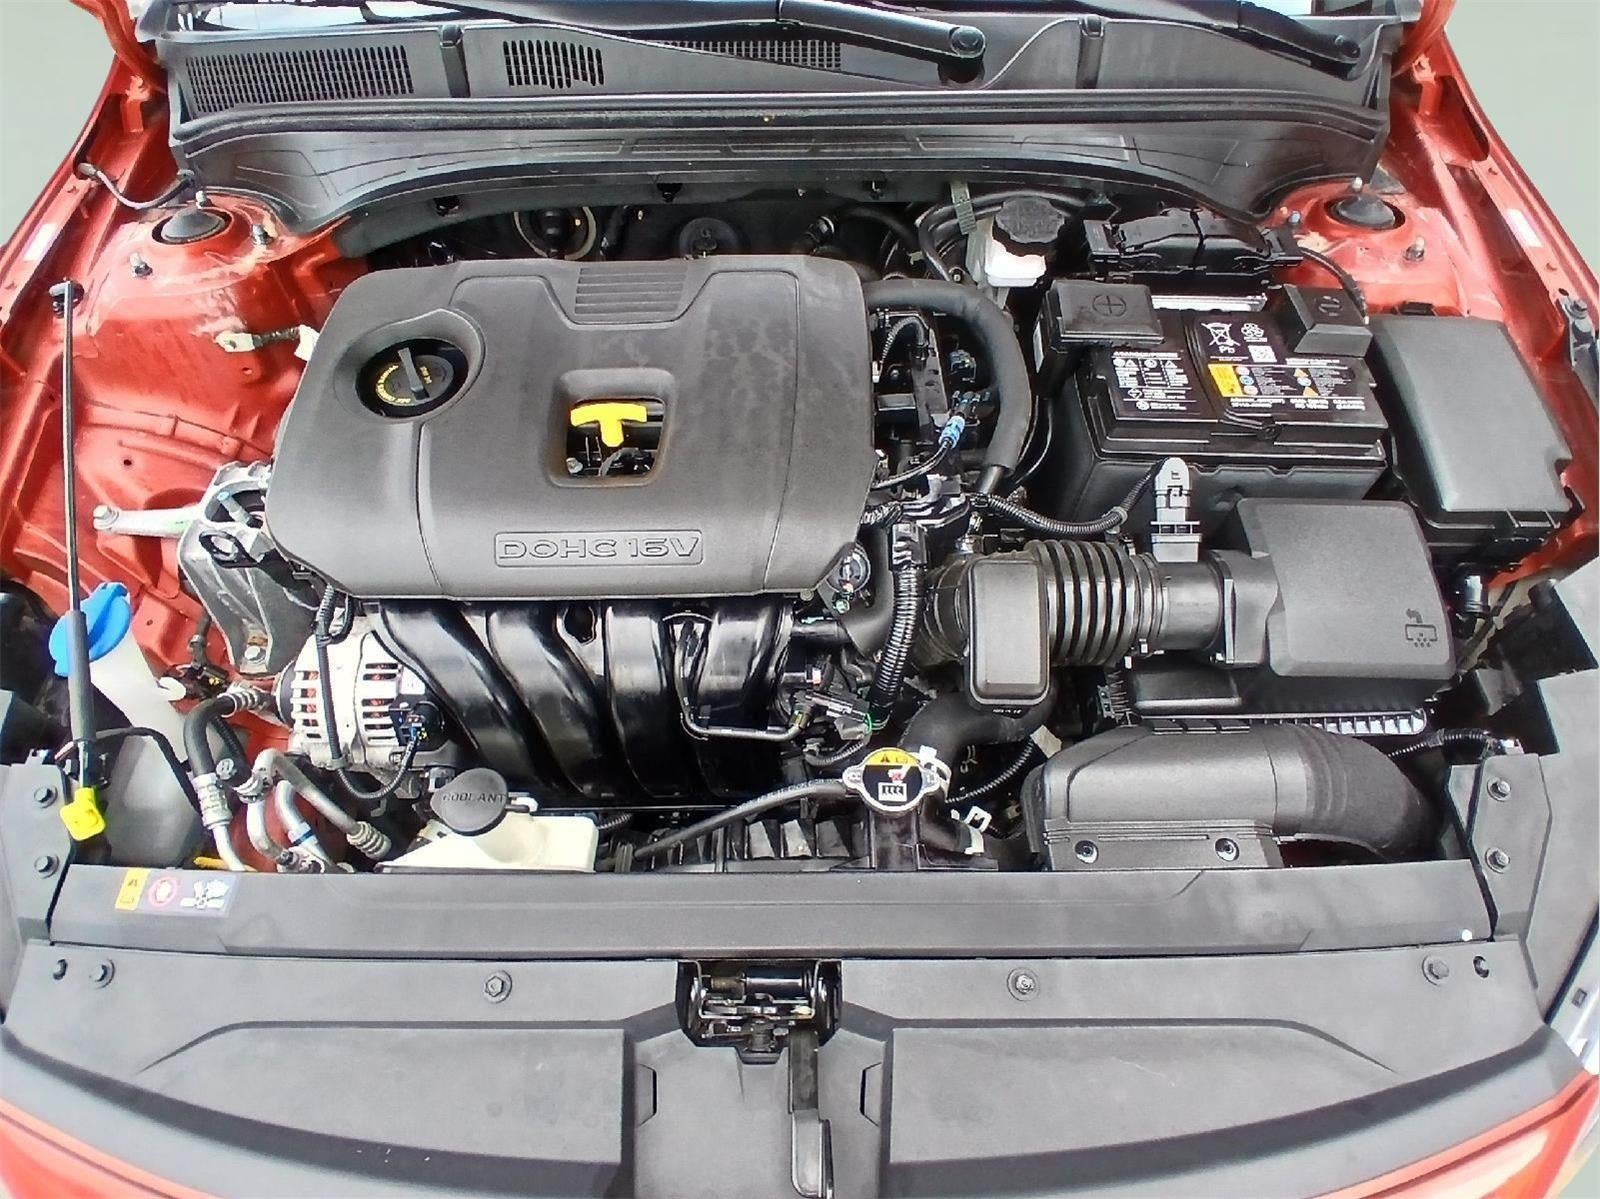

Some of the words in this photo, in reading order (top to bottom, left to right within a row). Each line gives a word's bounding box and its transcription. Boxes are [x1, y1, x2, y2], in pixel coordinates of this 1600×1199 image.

[1219, 345, 1235, 354] Pb
[499, 539, 617, 559] DOHC
[626, 537, 699, 557] 16V
[442, 792, 506, 804] COOLANT
